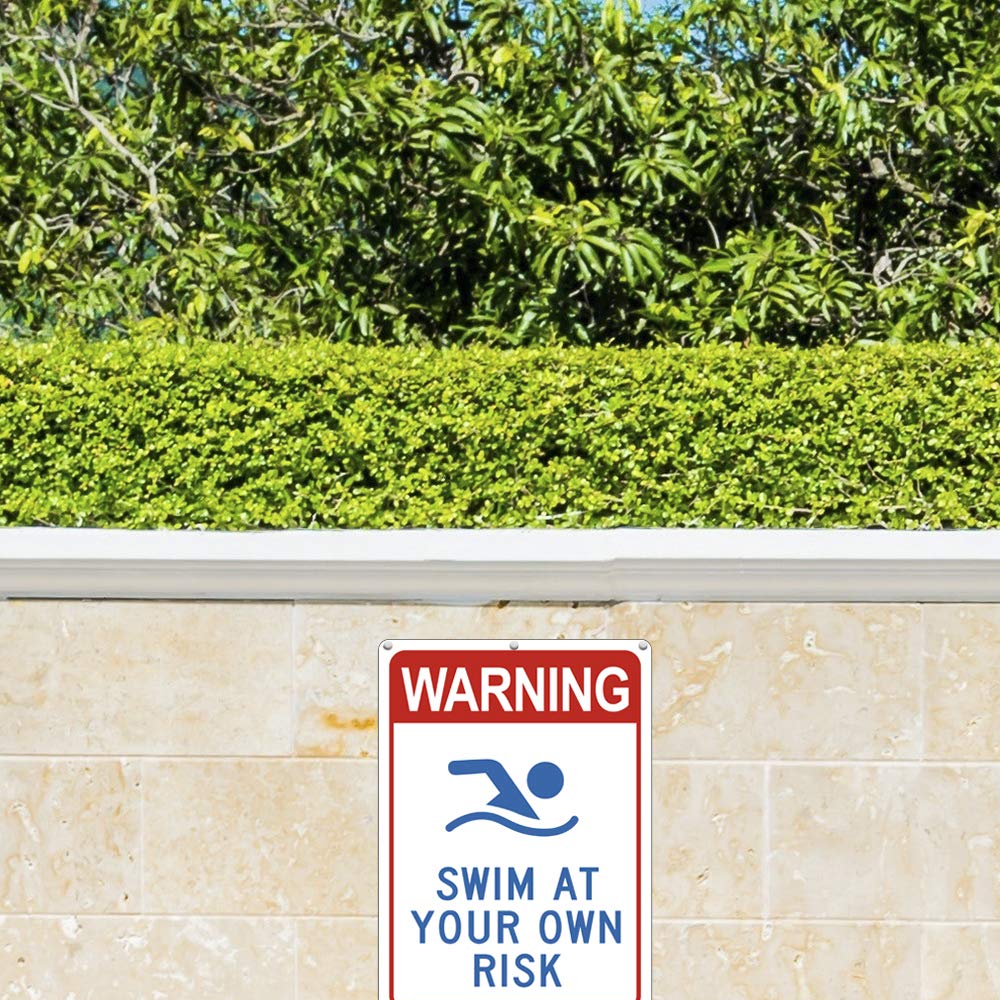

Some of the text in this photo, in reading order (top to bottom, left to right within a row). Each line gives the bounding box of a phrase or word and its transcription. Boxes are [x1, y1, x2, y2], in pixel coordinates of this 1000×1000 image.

[401, 666, 630, 713] WARNING
[436, 866, 600, 901] SWIM AT
[411, 909, 622, 945] YOUR OWN
[473, 953, 562, 988] RISK
